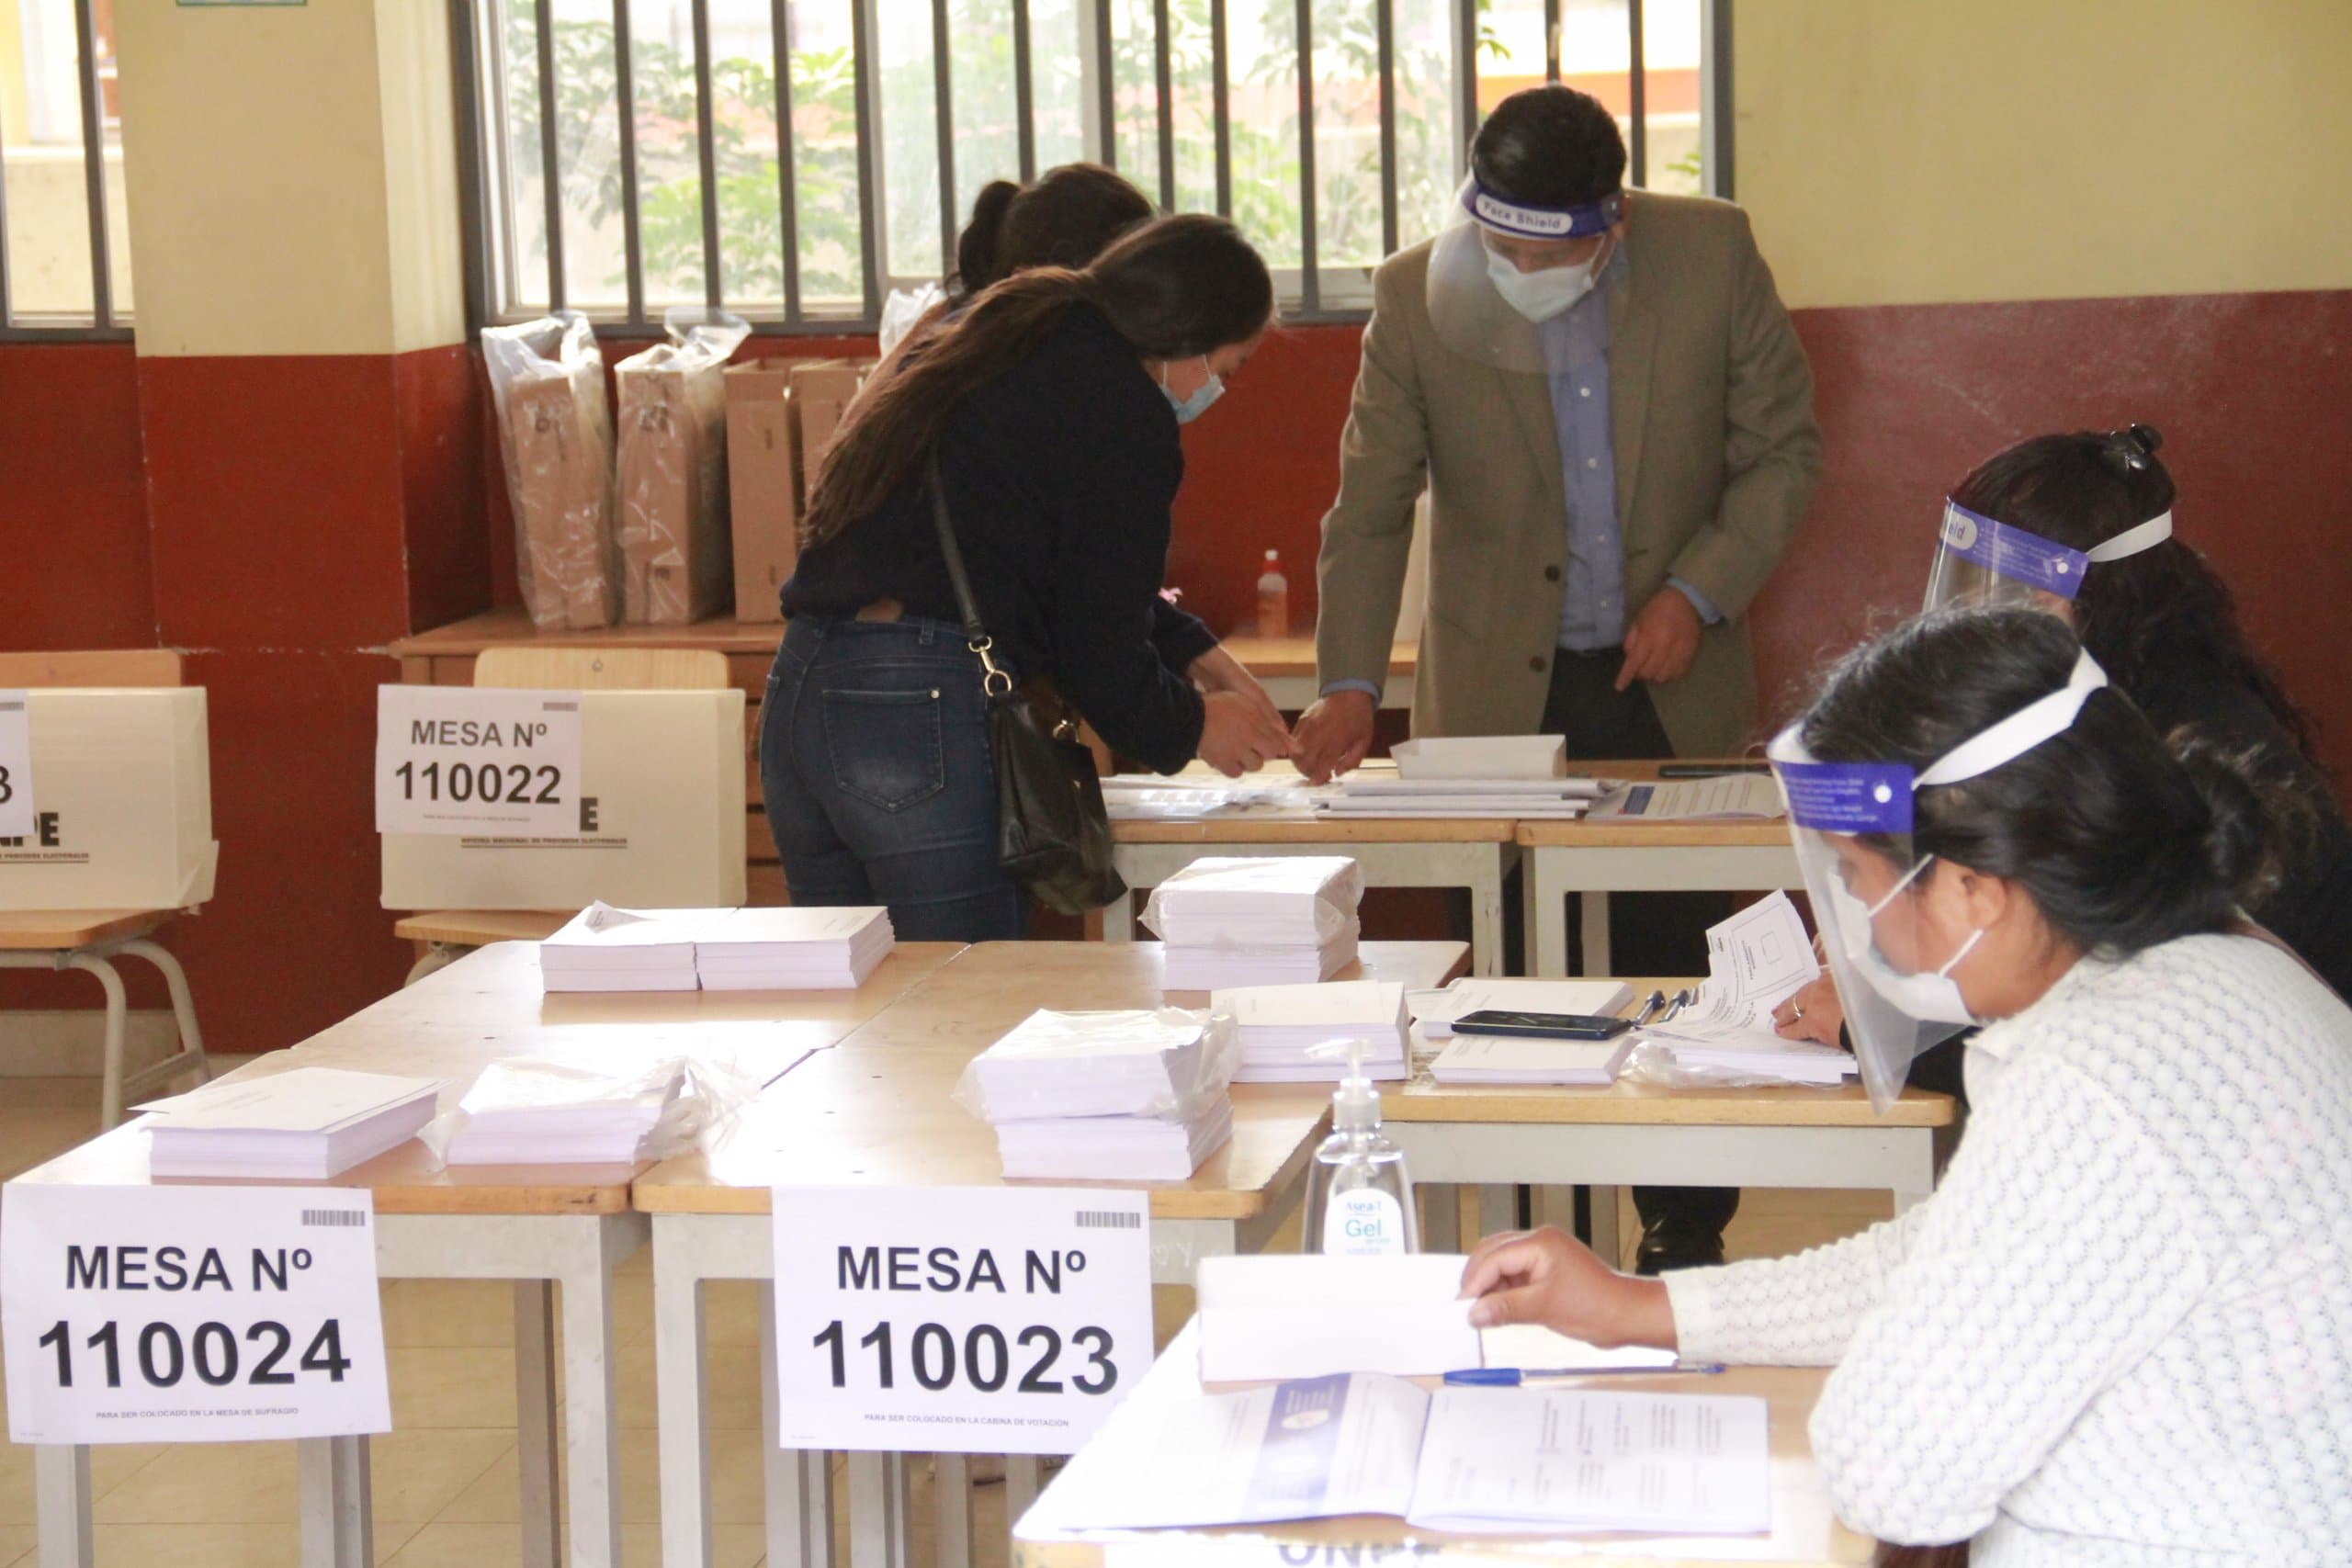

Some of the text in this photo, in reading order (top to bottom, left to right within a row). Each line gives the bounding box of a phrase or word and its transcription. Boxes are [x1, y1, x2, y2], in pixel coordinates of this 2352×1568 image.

[1516, 212, 1561, 230] Shield
[411, 719, 548, 748] MESA Nº
[395, 761, 561, 805] 110022
[1345, 1219, 1382, 1237] Gel
[66, 1245, 312, 1292] MESA Nº
[837, 1246, 1087, 1295] MESA Nº
[39, 1318, 352, 1390] 110024
[813, 1319, 1118, 1396] 110023
[96, 1411, 119, 1419] PARA
[121, 1411, 138, 1419] SER
[140, 1410, 188, 1418] COLOCADO
[216, 1409, 239, 1417] MESA
[254, 1407, 299, 1416] SUFRAGIO
[864, 1413, 887, 1421] PARA
[888, 1414, 904, 1422] SER
[906, 1415, 953, 1424] COLOCADO
[955, 1416, 967, 1424] EN
[968, 1416, 978, 1425] LA
[980, 1417, 1012, 1426] CABINA
